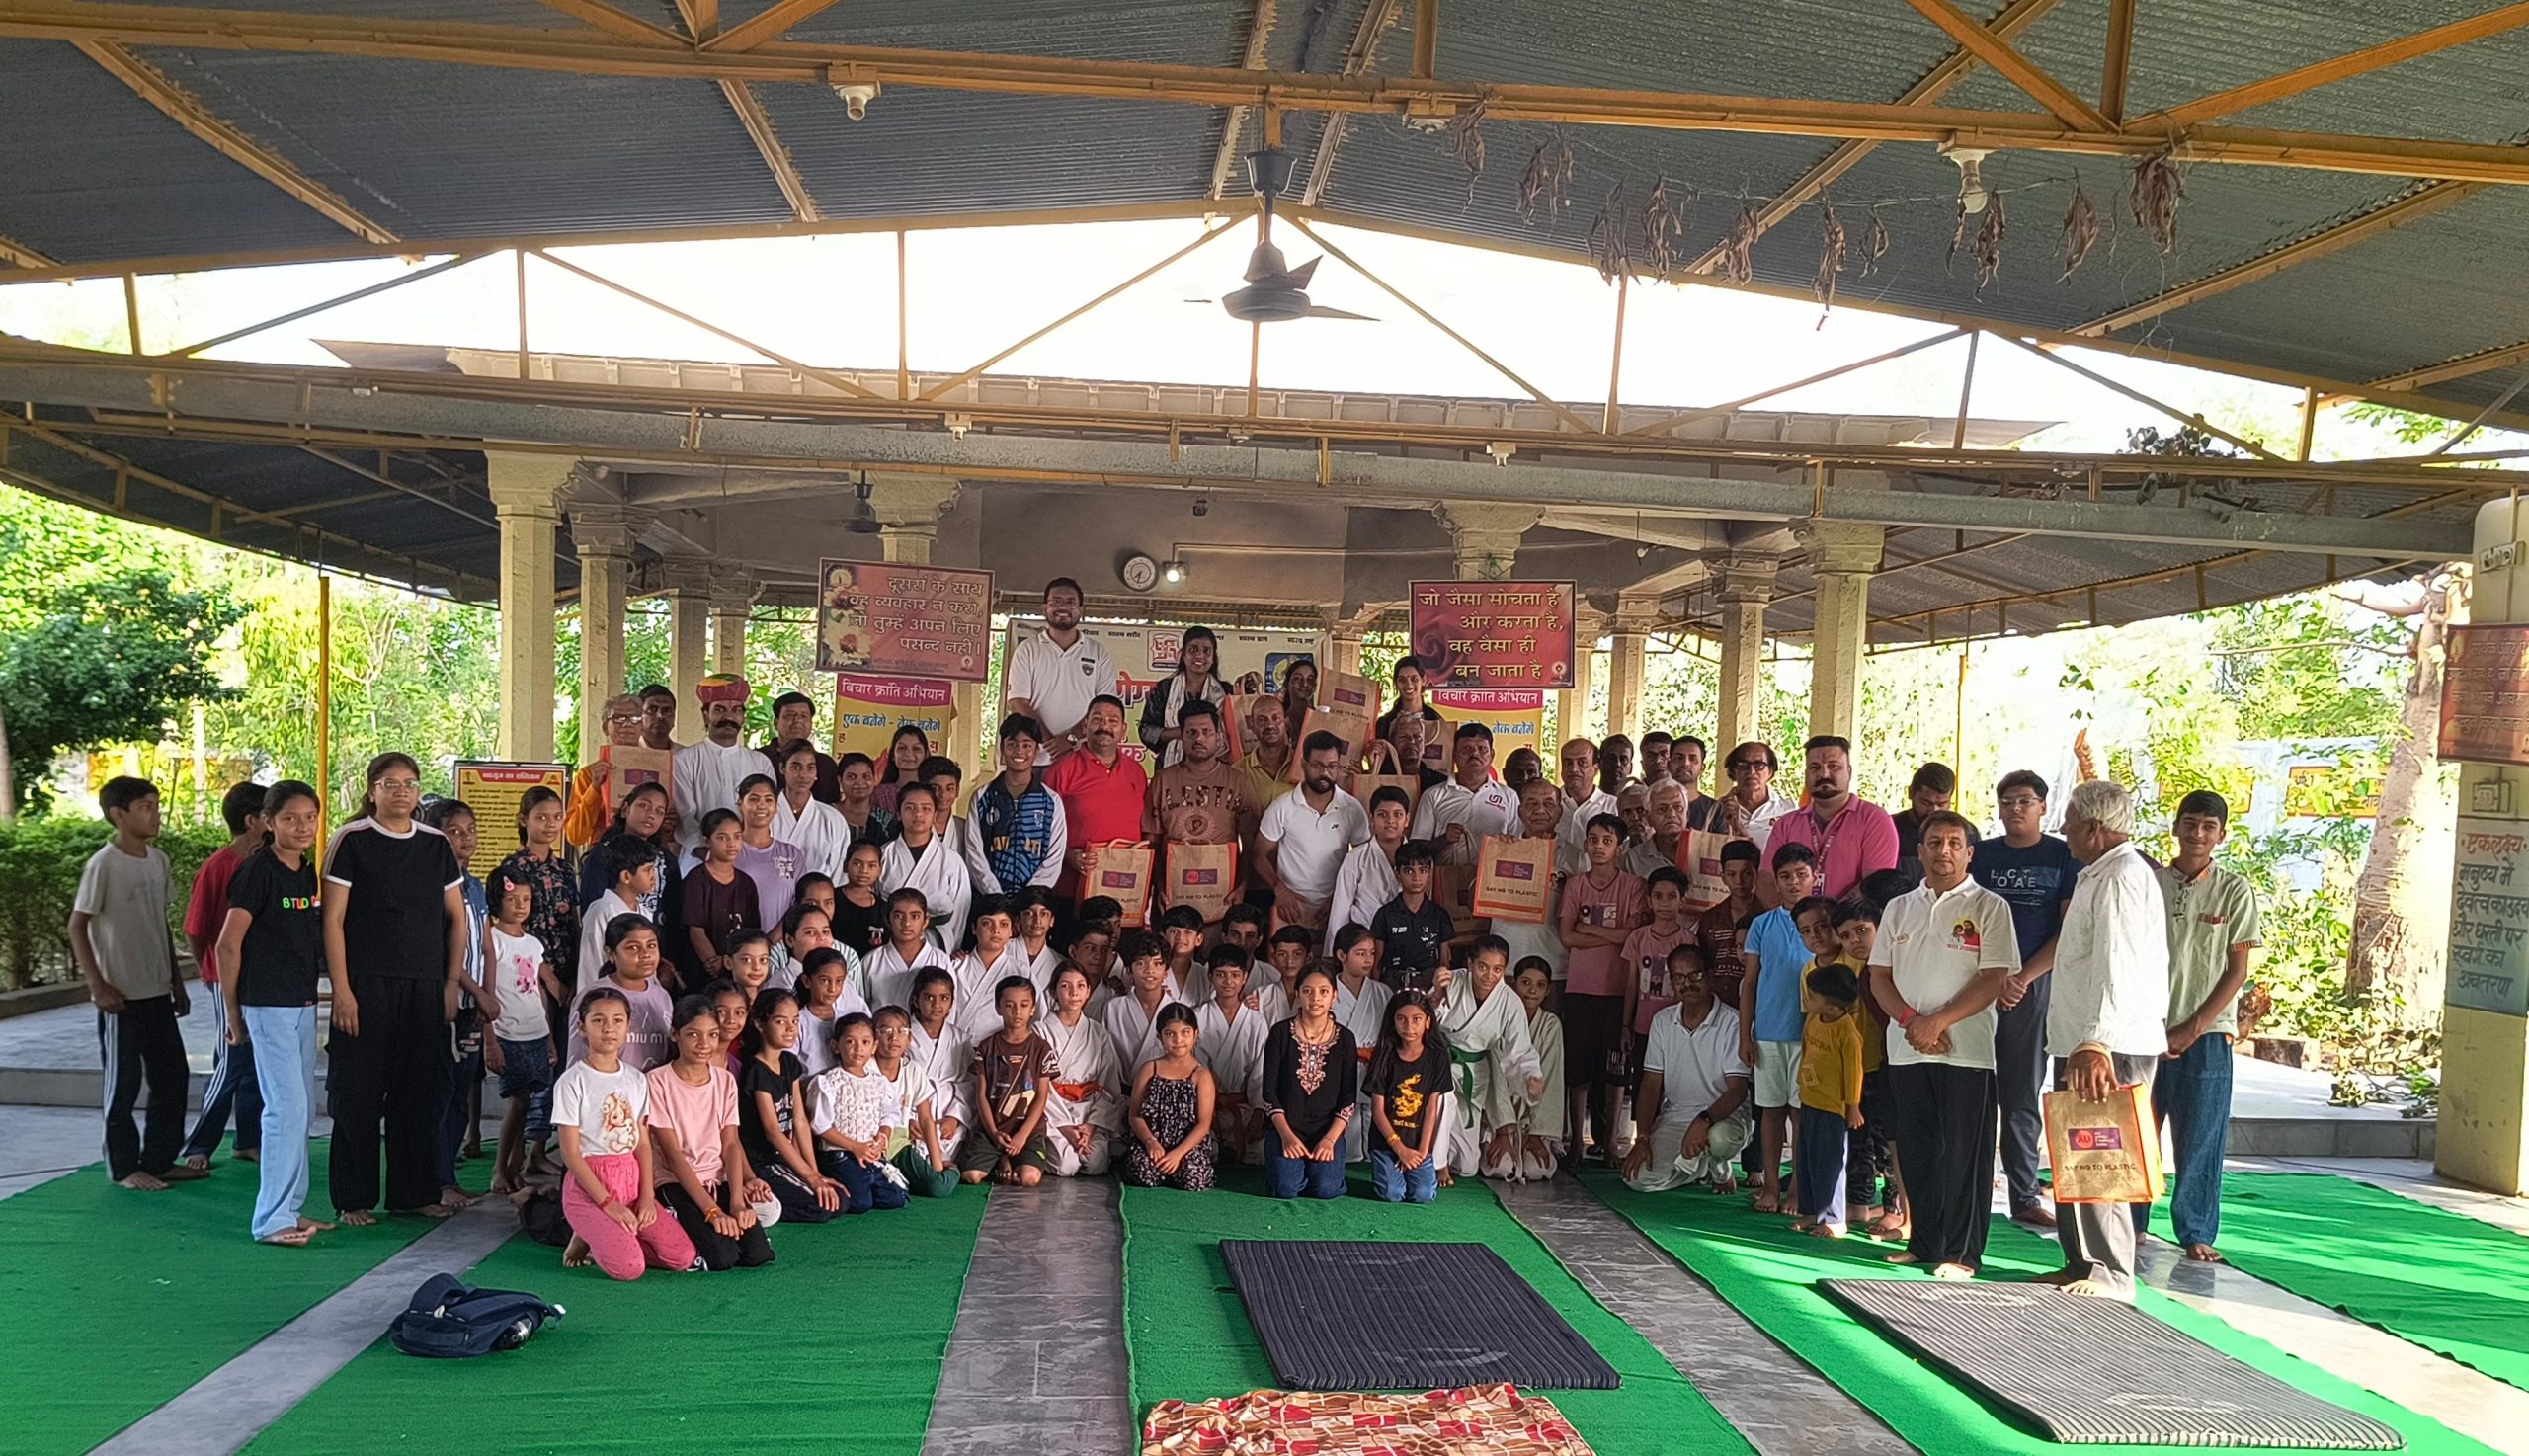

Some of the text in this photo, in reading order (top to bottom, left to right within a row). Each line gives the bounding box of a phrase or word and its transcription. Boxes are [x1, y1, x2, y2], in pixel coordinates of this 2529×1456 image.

[932, 575, 946, 593] के
[952, 582, 984, 596] साथ
[850, 594, 869, 606] वह
[875, 596, 927, 610] व्यवहार
[932, 600, 944, 611] न
[1418, 588, 1440, 606] जो
[1445, 587, 1483, 607] जैसा
[1488, 588, 1541, 607] सोचता
[849, 611, 981, 637] जो तुम्हें अपने लिए
[1460, 611, 1491, 629] और
[1496, 615, 1540, 629] करता
[900, 637, 940, 652] पसन्द
[1448, 634, 1536, 654] वह वैसा ही
[1454, 659, 1543, 679] बन जाता है
[842, 678, 945, 701] विचार क्रांति अभियान
[843, 713, 860, 729] एक
[2460, 856, 2515, 891] मनुष्य में
[2504, 927, 2528, 951] पर
